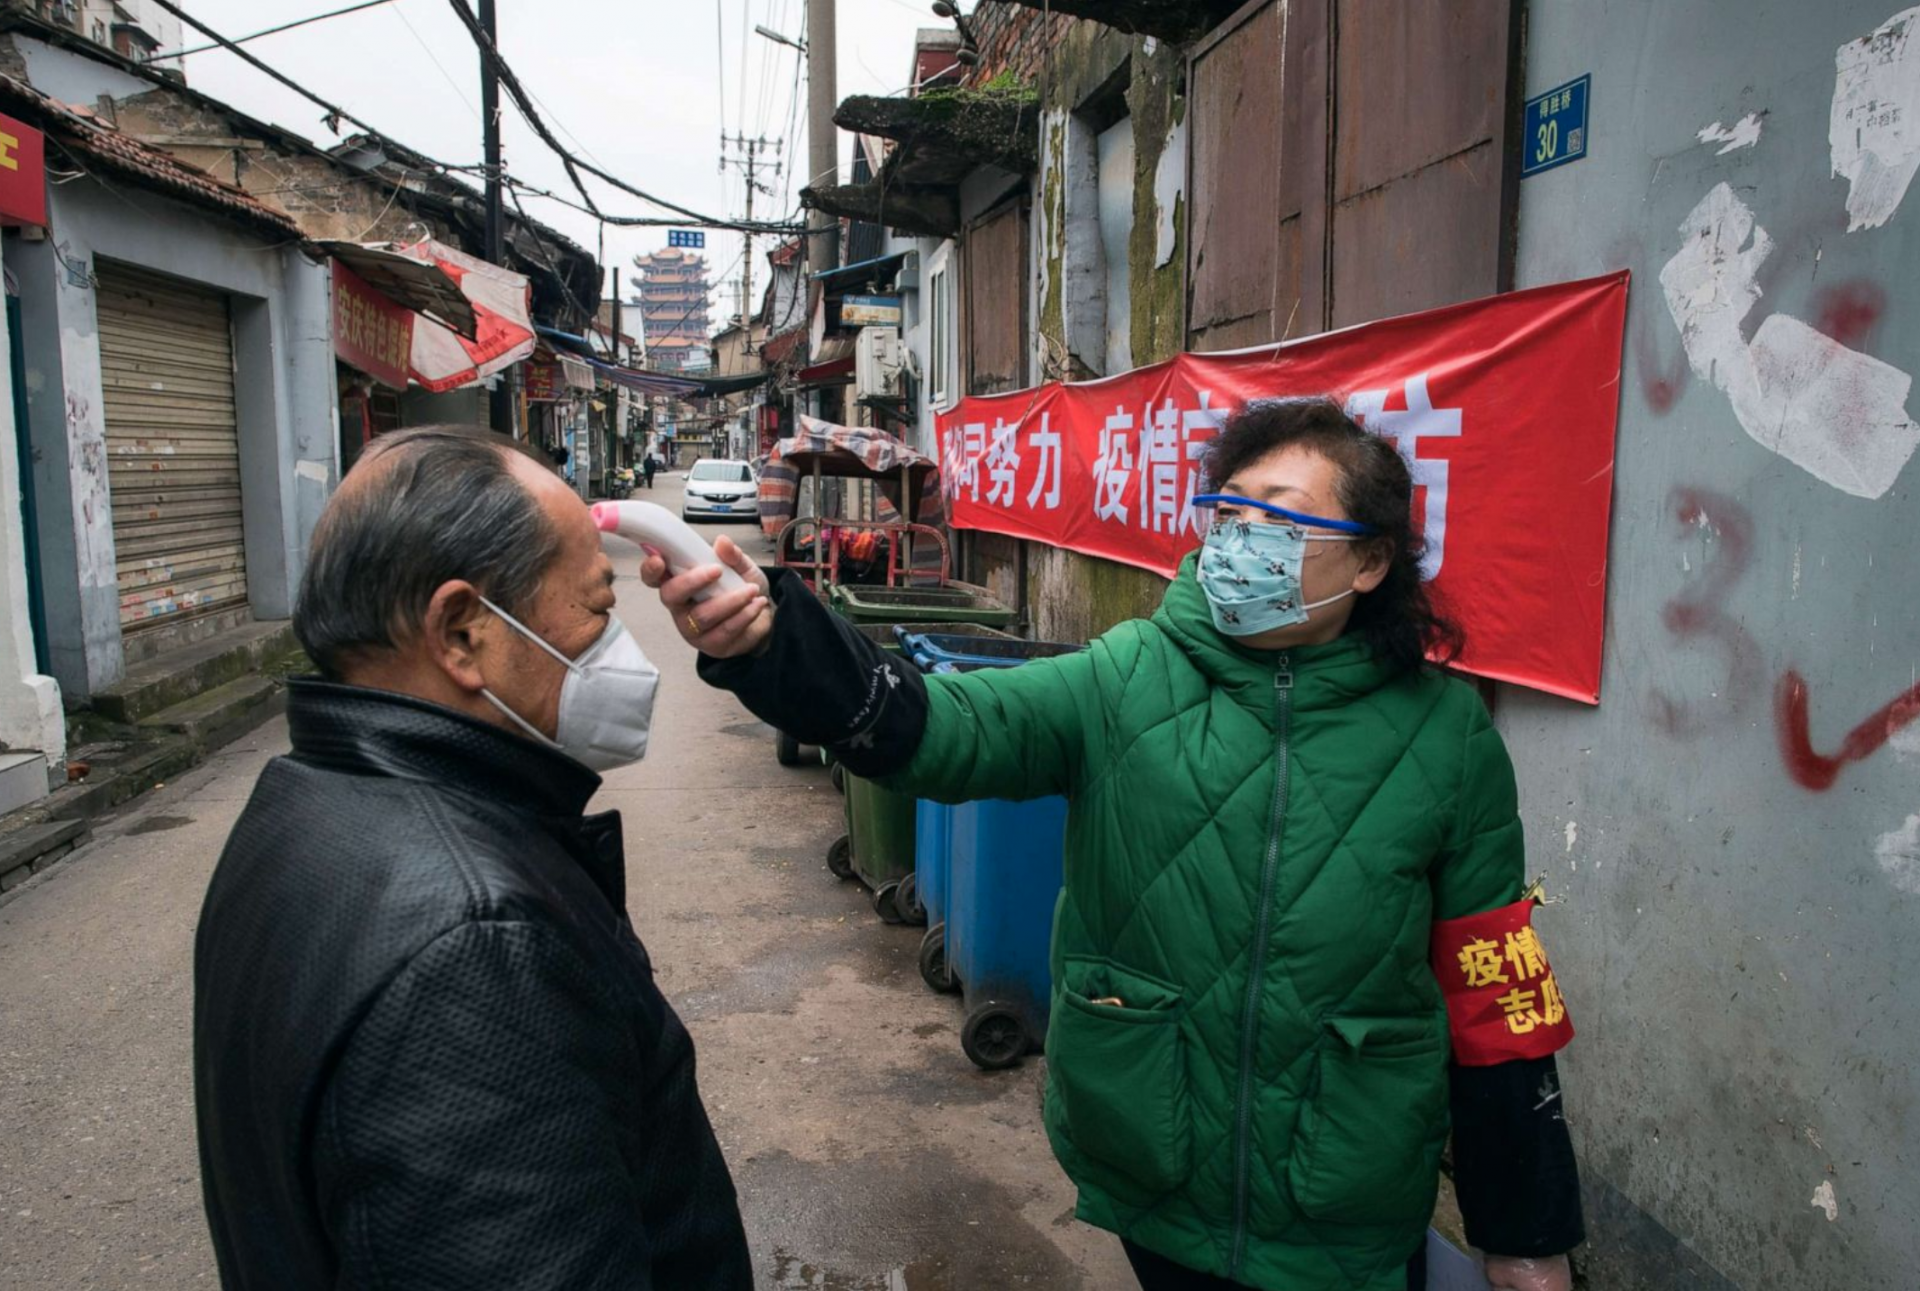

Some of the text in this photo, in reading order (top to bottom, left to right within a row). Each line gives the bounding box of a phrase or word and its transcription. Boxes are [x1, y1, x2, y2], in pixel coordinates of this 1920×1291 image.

[1540, 91, 1571, 118] 得胜桥
[1536, 119, 1558, 162] 30
